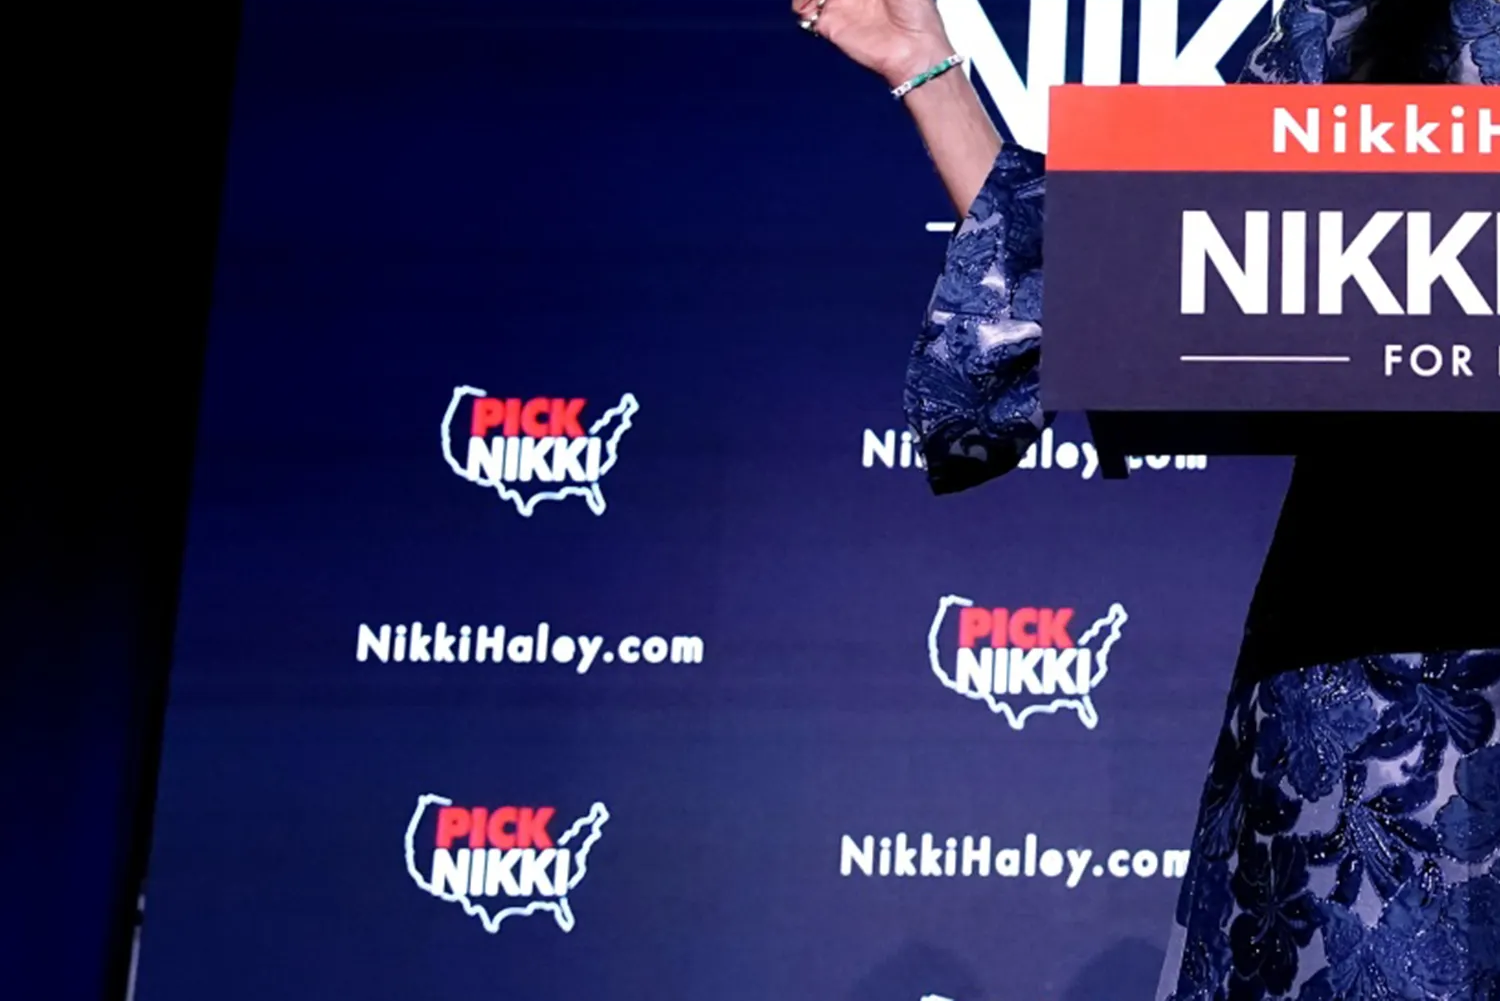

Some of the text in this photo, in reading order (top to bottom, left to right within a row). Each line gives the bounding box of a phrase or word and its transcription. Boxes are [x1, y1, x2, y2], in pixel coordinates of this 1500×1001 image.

[1384, 344, 1473, 377] FOR
[471, 397, 587, 437] PICK
[466, 436, 601, 482] NIKKI
[356, 621, 704, 674] NikkiHaley.com
[958, 607, 1075, 649] PICK
[955, 648, 1091, 695] NIKKI
[435, 806, 556, 849] PICK
[431, 847, 571, 897] NIKKI
